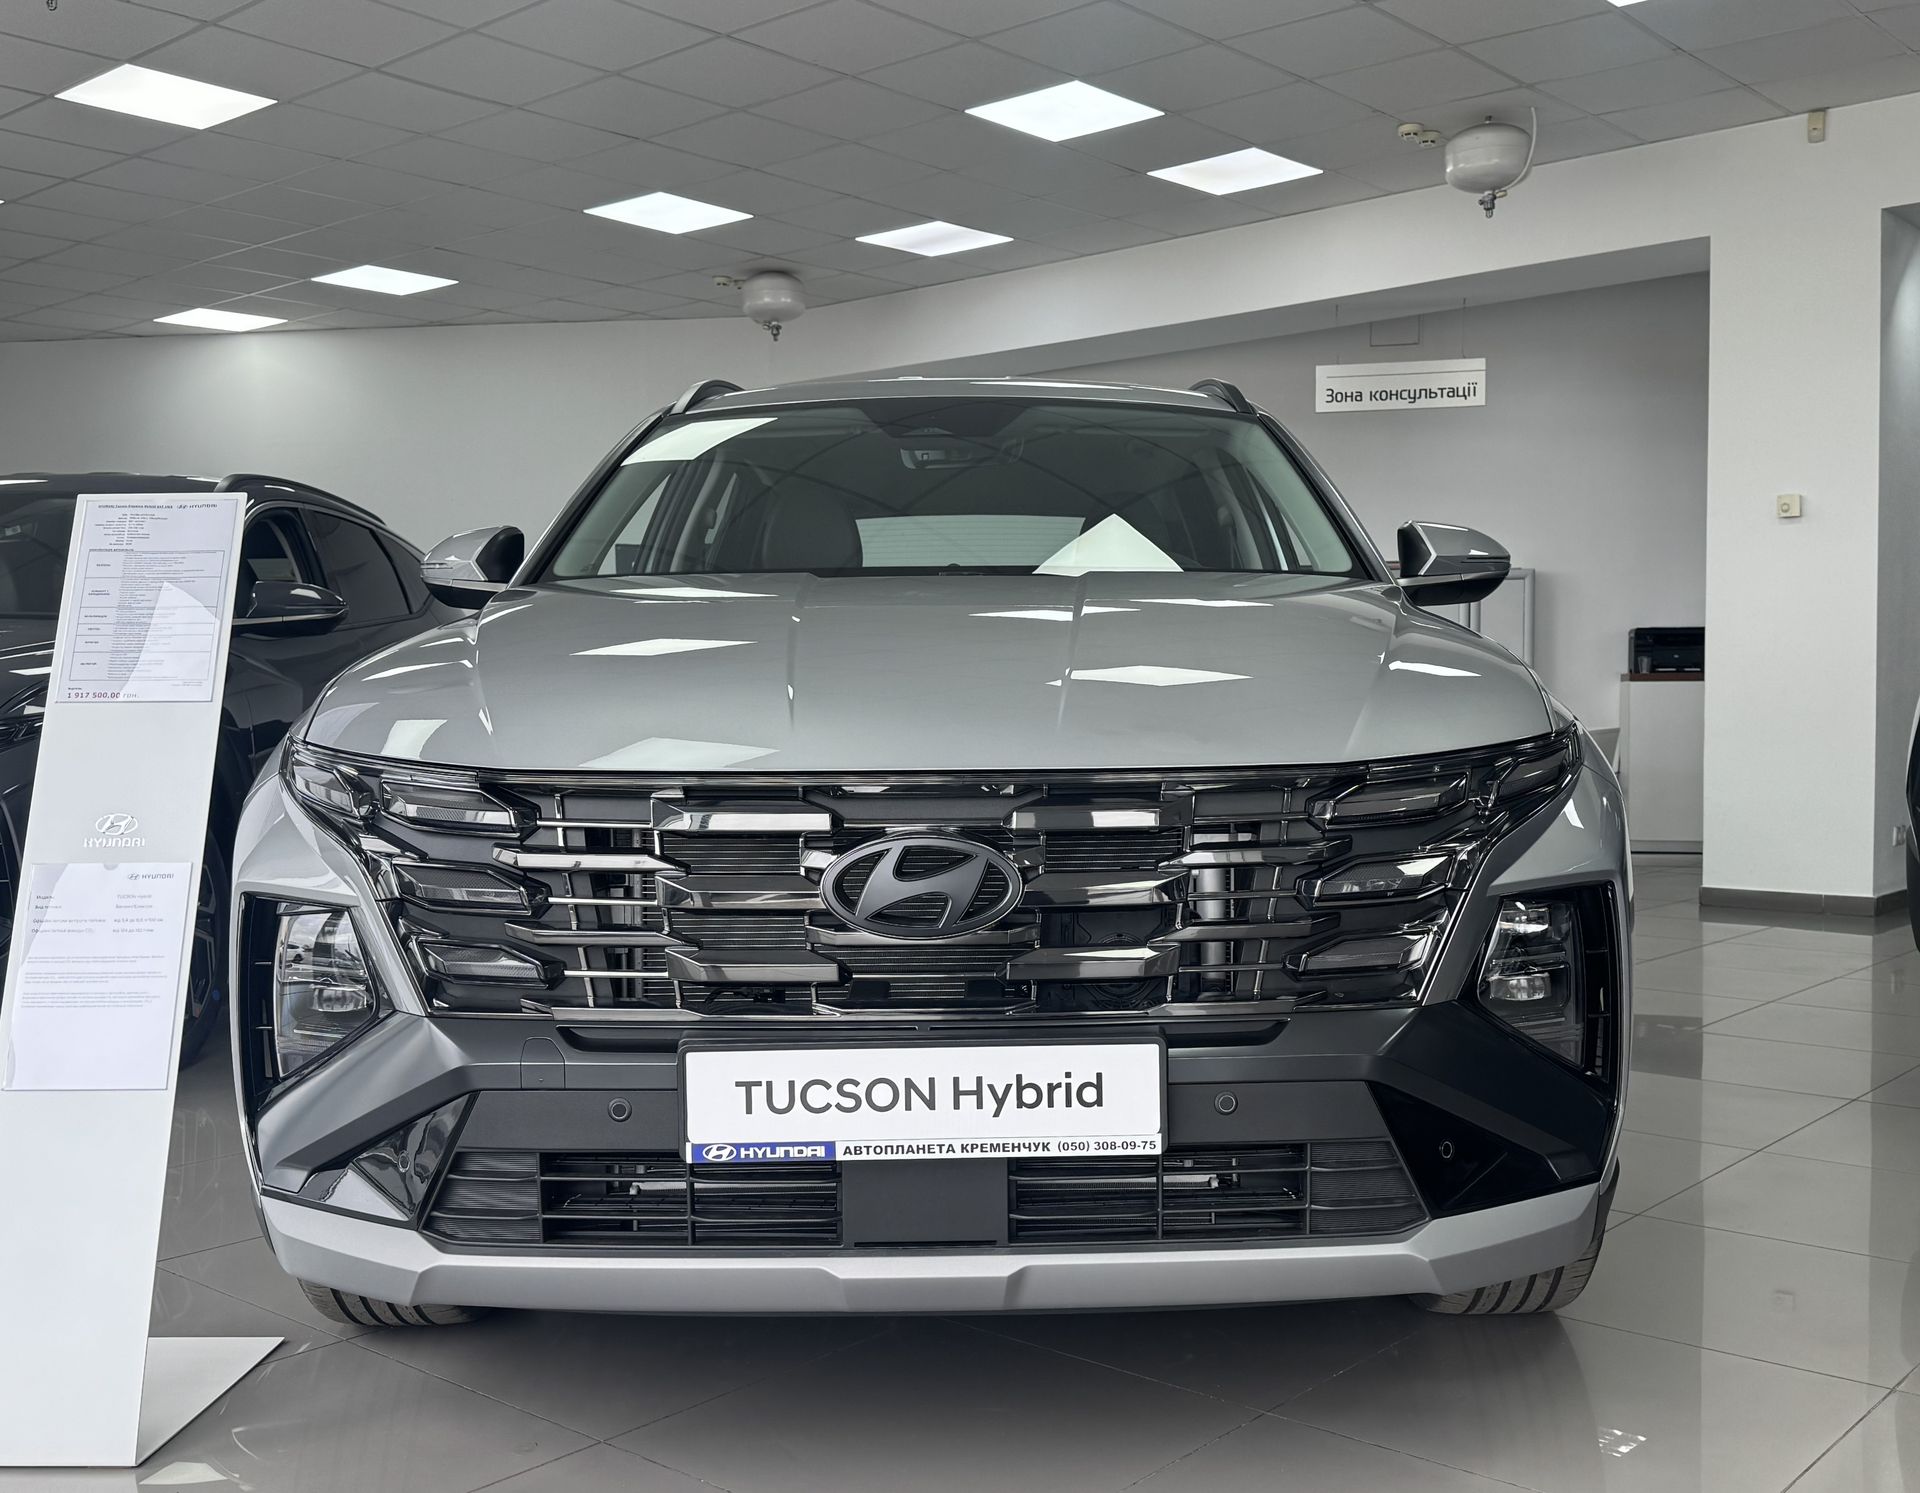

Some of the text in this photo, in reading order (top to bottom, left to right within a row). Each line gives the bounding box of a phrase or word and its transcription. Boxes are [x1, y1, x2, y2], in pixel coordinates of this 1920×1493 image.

[1325, 382, 1478, 404] Зона консультації
[83, 837, 146, 848] HYUNDAI
[734, 1071, 1104, 1118] TUCSON Hybrid
[740, 1146, 826, 1158] HYUNDAI
[842, 1140, 1157, 1157] АВТОПЛАНЕТА КРЕМЕНЧУК (050) 308-09-75
